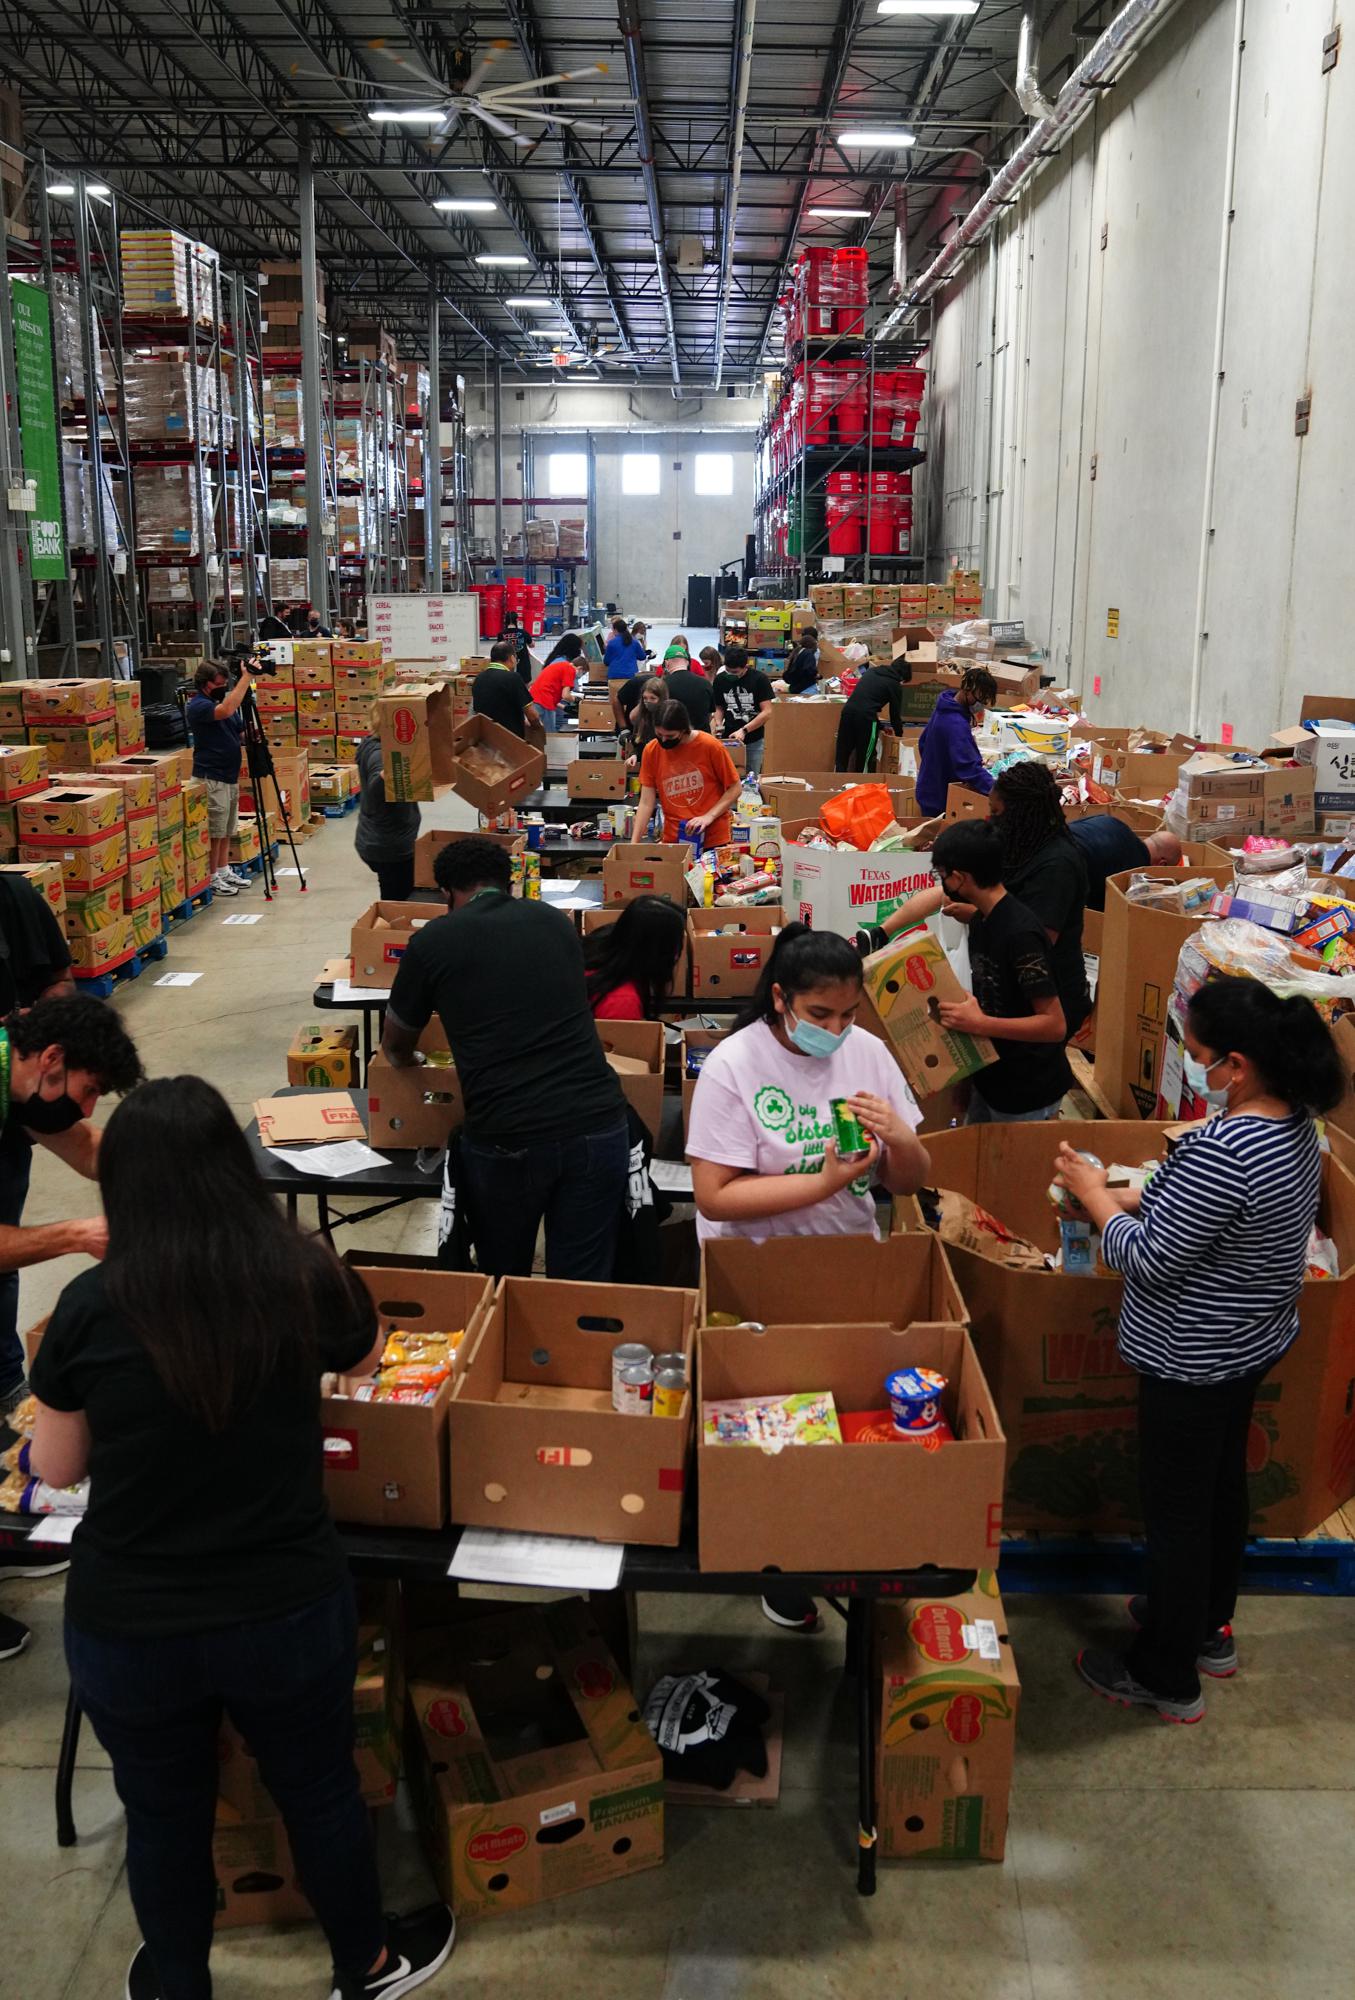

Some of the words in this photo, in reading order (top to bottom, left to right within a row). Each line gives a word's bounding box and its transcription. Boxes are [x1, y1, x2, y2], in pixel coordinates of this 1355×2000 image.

[17, 302, 31, 317] OUR
[18, 319, 44, 337] MISSION
[38, 538, 62, 555] BANK
[666, 775, 697, 793] TEXAS
[860, 868, 891, 881] TEXAS
[849, 872, 936, 906] WATERMELONS
[799, 1104, 817, 1119] big
[785, 1121, 835, 1144] siste
[803, 1142, 825, 1156] littl
[784, 1155, 827, 1174] sist
[931, 1606, 948, 1625] Del
[932, 1624, 953, 1660] Monte
[592, 1795, 650, 1819] Premium
[594, 1804, 660, 1833] BANANAS
[956, 1799, 970, 1848] Premium
[471, 1838, 490, 1854] Del
[490, 1832, 526, 1849] Monte
